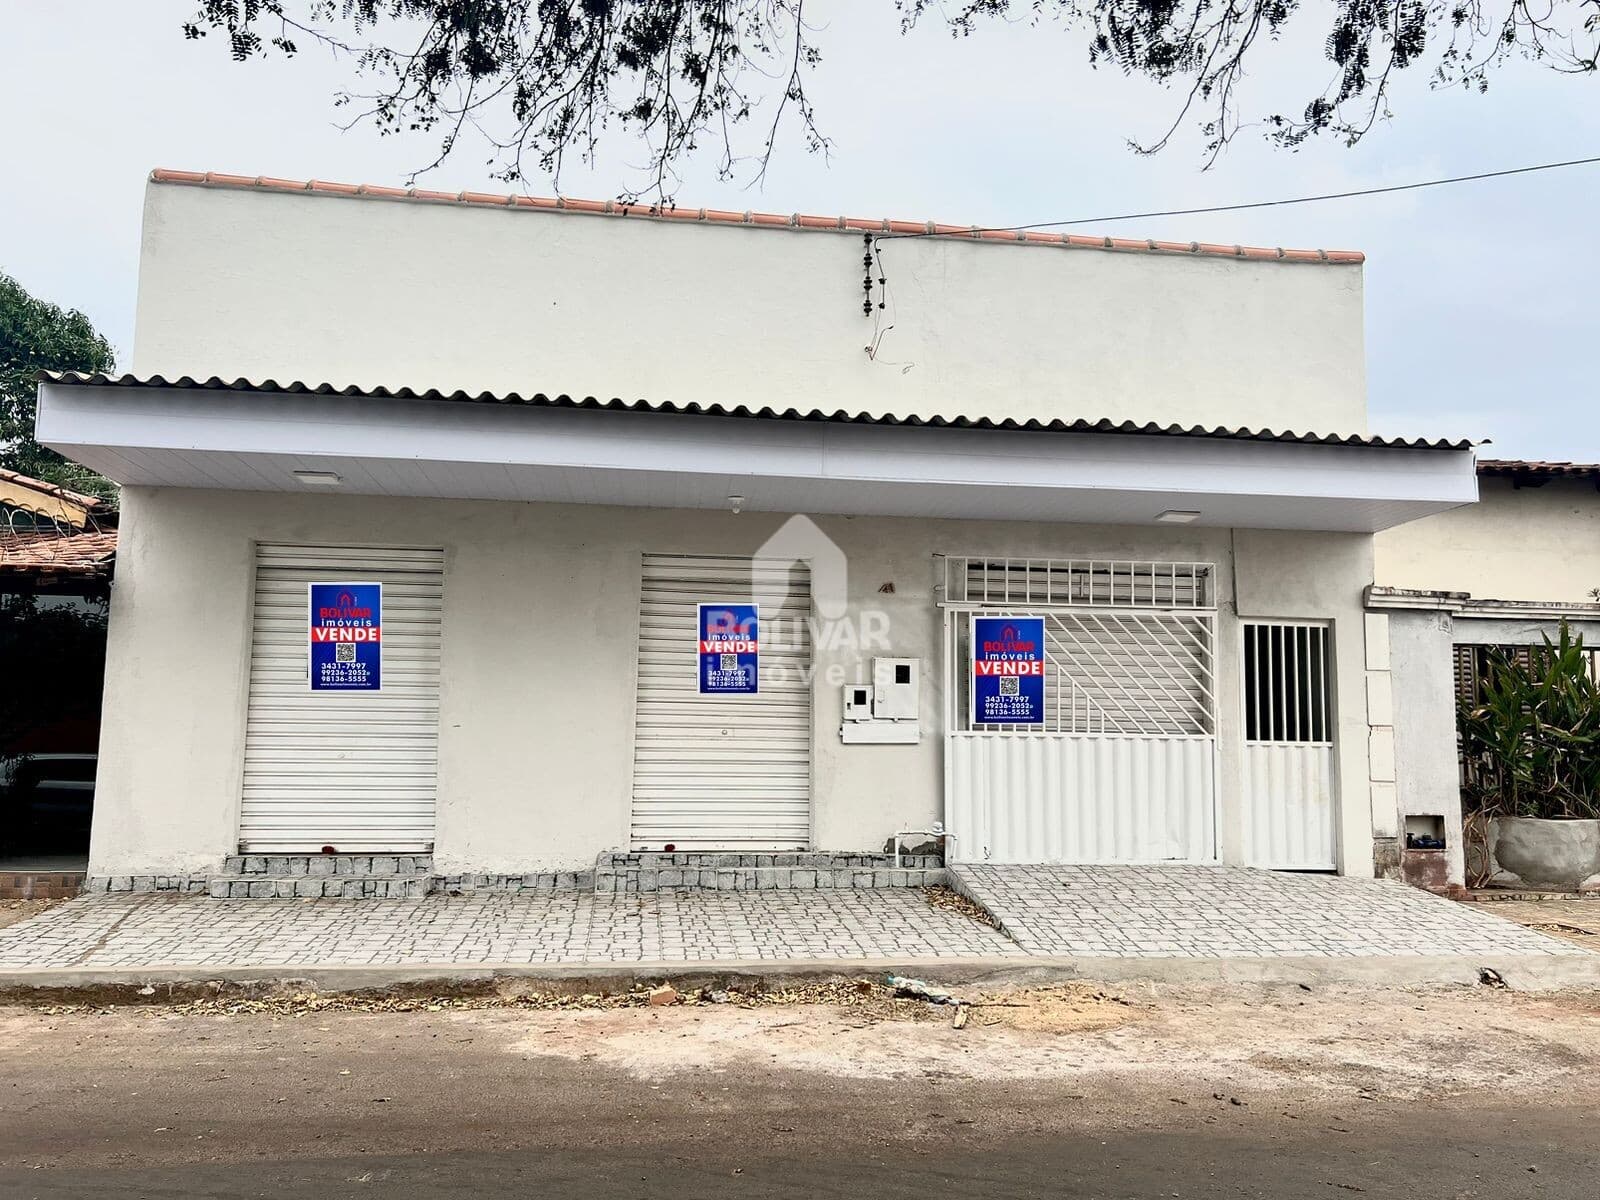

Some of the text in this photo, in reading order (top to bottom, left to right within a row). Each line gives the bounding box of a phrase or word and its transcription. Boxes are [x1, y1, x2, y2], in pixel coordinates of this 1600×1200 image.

[320, 607, 371, 618] BOLIVAR
[321, 618, 372, 627] imóveis
[316, 627, 377, 641] VENDE
[708, 633, 751, 641] imóveis
[703, 641, 756, 653] VENDE
[984, 641, 1034, 652] BOLIVAR
[985, 651, 1035, 661] imóveis
[321, 662, 366, 670] 3431-7997
[980, 661, 1040, 675] VENDE
